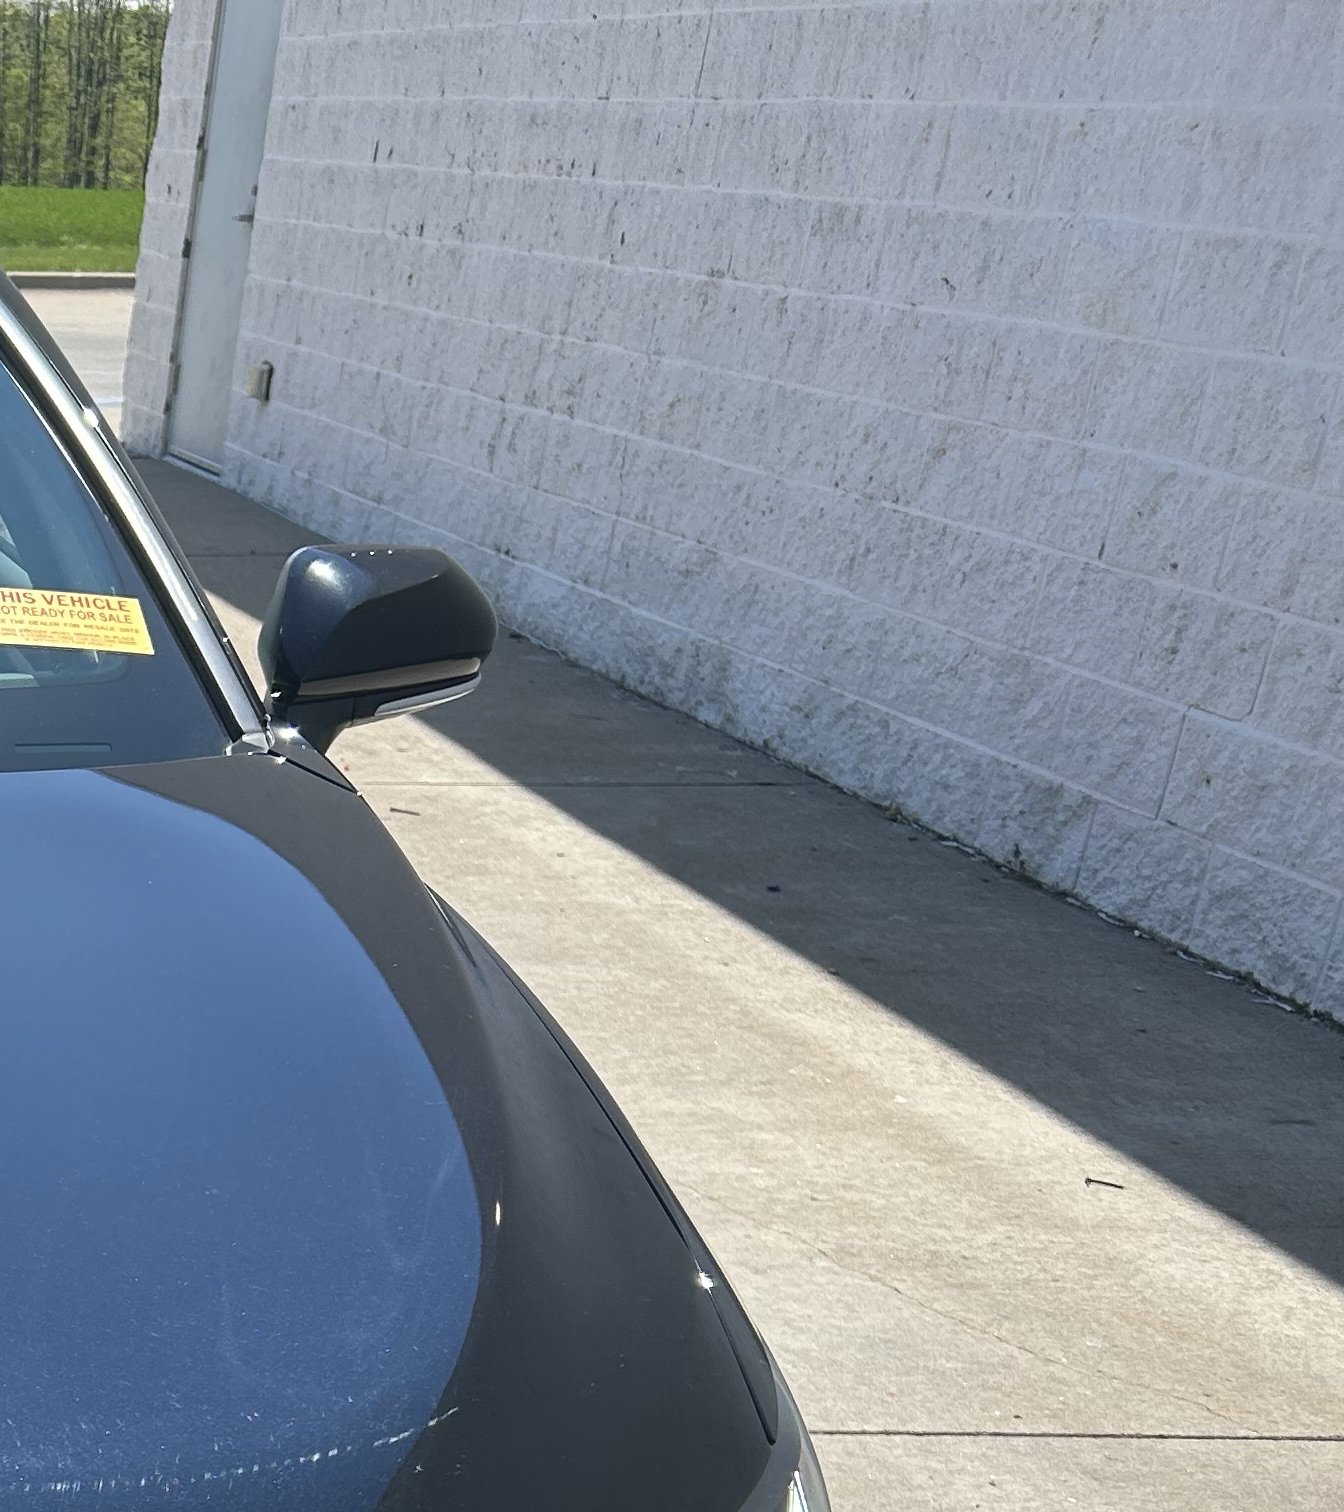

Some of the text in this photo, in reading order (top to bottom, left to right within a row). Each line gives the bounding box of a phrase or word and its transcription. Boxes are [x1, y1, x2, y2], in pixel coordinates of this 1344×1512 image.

[41, 594, 131, 612] VEHICLE
[22, 606, 65, 619] READY
[69, 609, 96, 621] FOR
[99, 612, 133, 624] SALE
